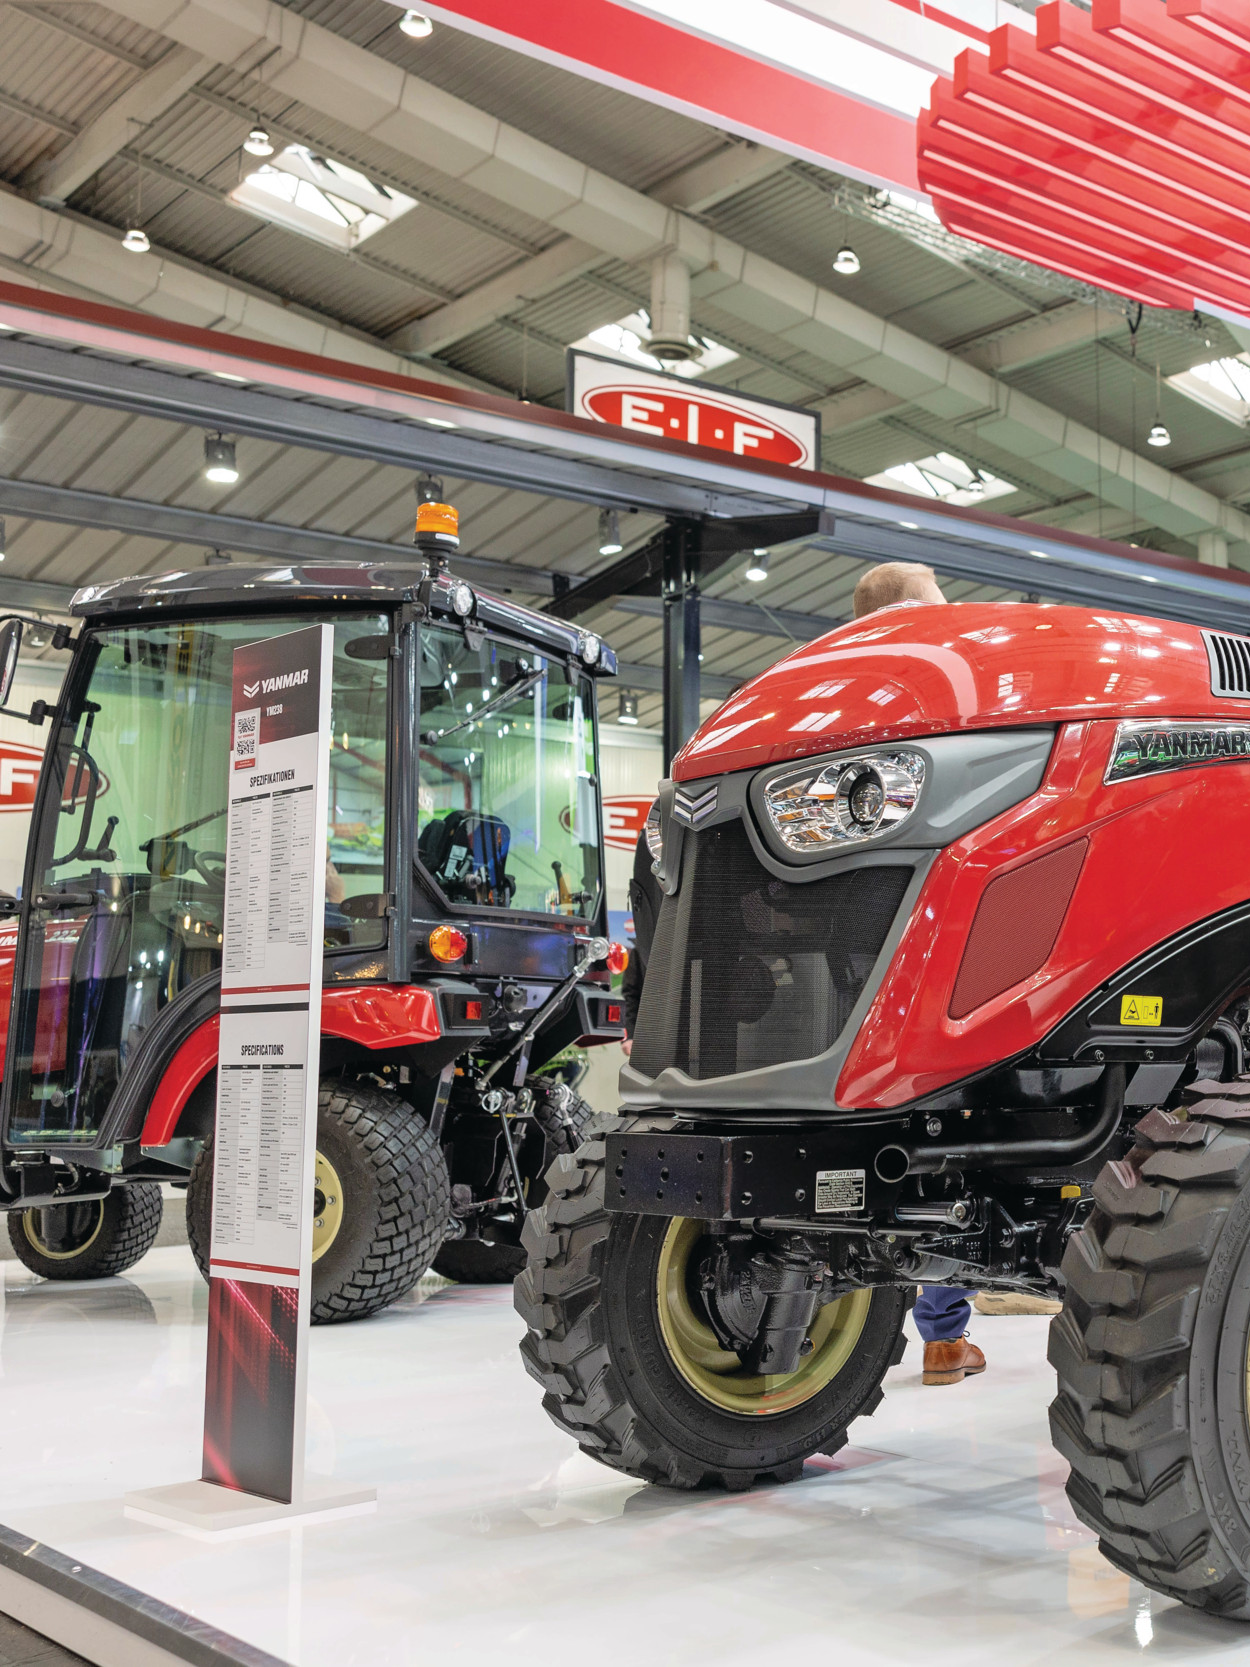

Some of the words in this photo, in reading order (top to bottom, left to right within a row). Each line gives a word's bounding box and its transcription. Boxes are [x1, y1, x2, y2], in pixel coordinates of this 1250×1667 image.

[261, 669, 309, 694] YANMAR
[266, 704, 283, 717] YM238
[1133, 730, 1249, 760] YANMAR
[249, 769, 296, 788] SPEZIFIKATIONEN
[52, 928, 79, 941] 222
[240, 1044, 284, 1056] SPECIFICATIONS
